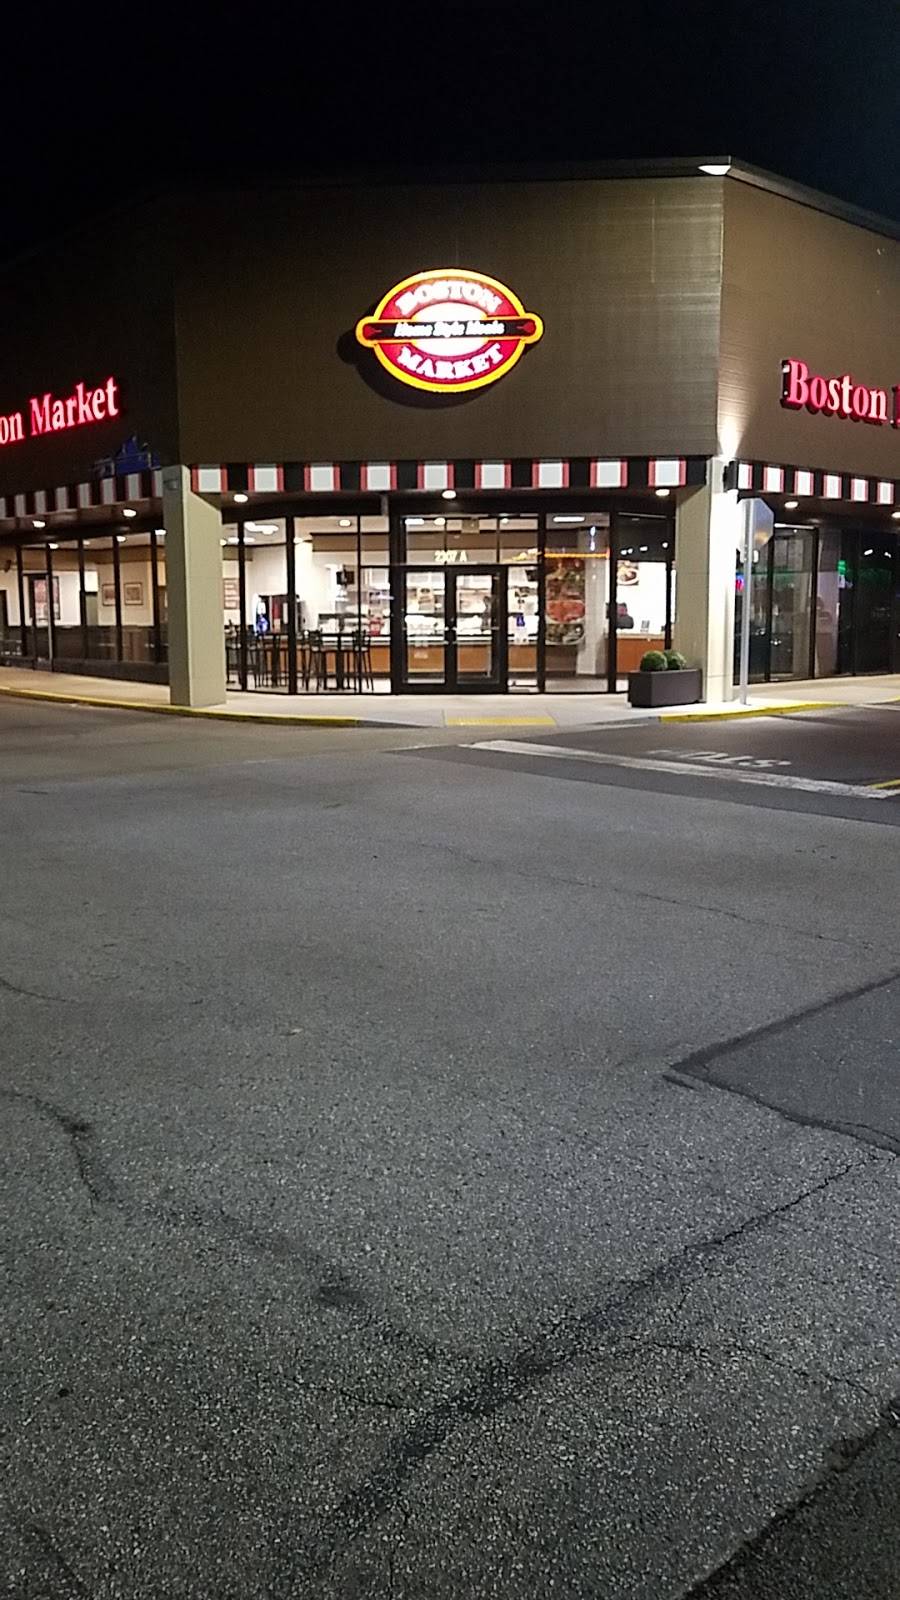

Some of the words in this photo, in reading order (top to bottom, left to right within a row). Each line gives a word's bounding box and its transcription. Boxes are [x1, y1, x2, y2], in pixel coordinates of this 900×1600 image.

[395, 280, 503, 315] BOSTON
[396, 343, 504, 380] MARKET
[29, 376, 120, 436] Market
[785, 358, 888, 422] Boston
